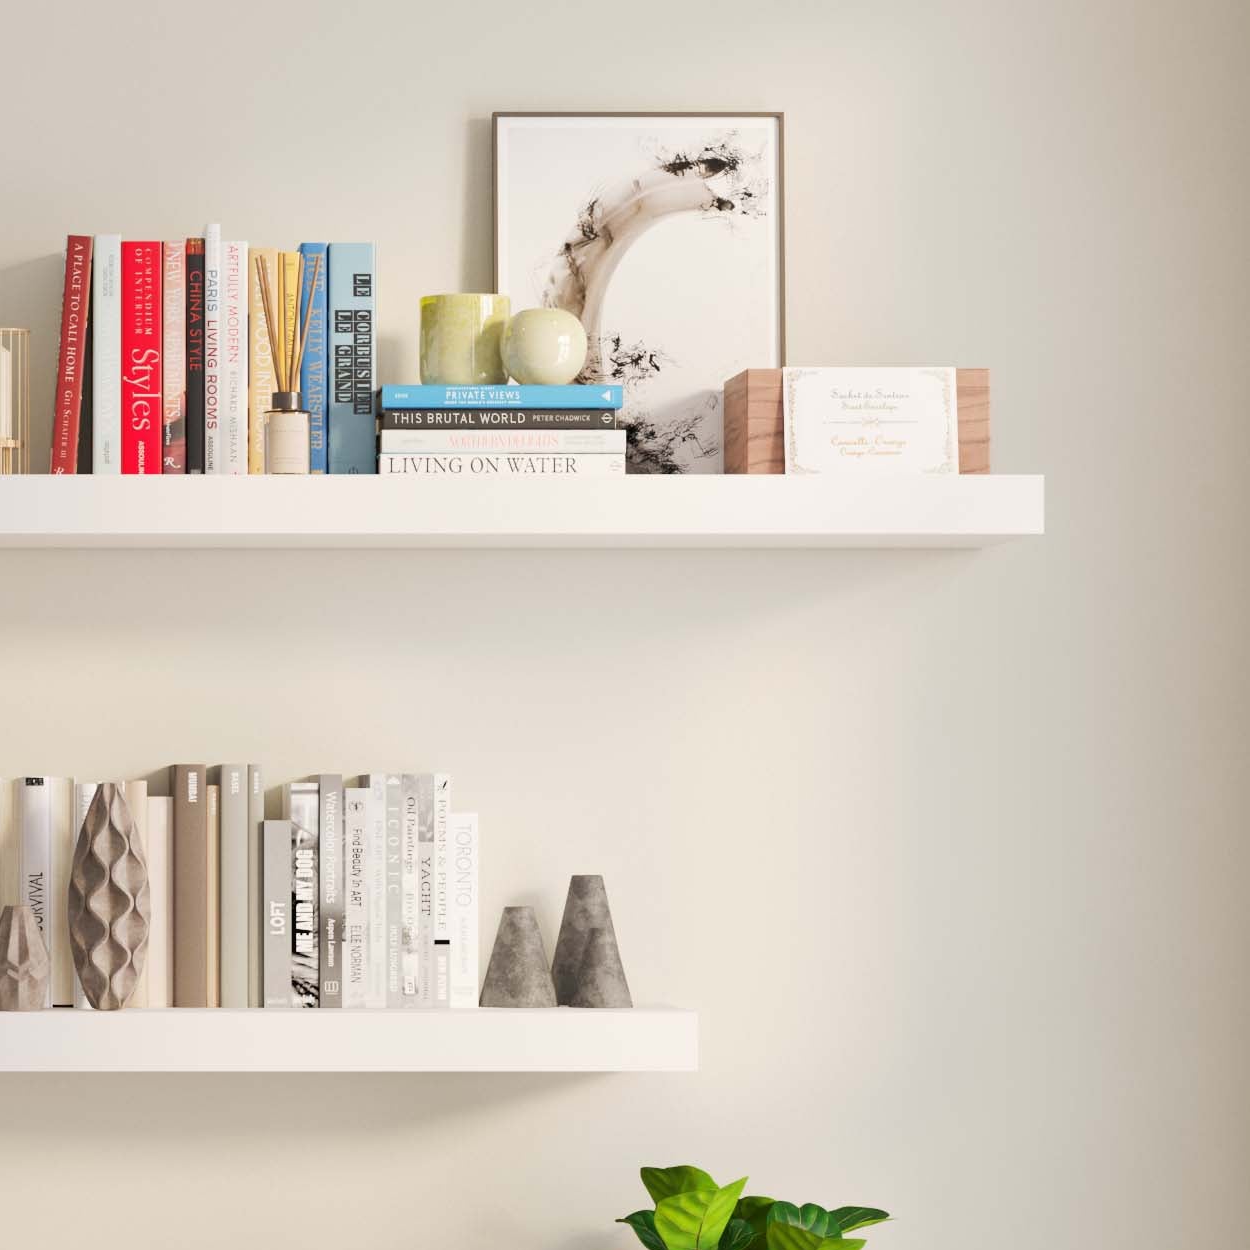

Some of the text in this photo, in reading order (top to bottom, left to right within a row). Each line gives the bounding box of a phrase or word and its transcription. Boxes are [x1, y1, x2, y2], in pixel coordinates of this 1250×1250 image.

[71, 255, 83, 290] PLACE
[74, 242, 84, 252] A
[166, 251, 180, 285] NEW
[228, 245, 239, 300] ARTFULLY
[70, 291, 80, 311] TO
[134, 248, 143, 335] OF INTERIOR
[144, 248, 153, 336] COMPENDIUM
[67, 312, 79, 343] CALL
[190, 270, 202, 371] CHINA STYLE
[228, 305, 239, 363] MODERN
[308, 309, 323, 354] KELLY
[354, 274, 371, 414] LE CORBUSIER
[65, 344, 77, 383] HOME
[207, 270, 218, 430] PARIS LIVING ROOMS
[335, 310, 352, 403] LE GRAND
[123, 348, 162, 432] Styles
[309, 360, 324, 450] WEARSTLER
[445, 391, 520, 400] PRIVATE VIEWS
[392, 412, 591, 425] THIS BRUTAL WORLD PETER CHADWICK
[389, 457, 578, 474] LIVING ON WATER
[326, 791, 338, 851] Watercolor
[352, 828, 362, 846] Find
[406, 796, 416, 874] Oil Paintings
[351, 847, 363, 877] Beauty
[388, 808, 399, 897] ICONIC
[437, 799, 446, 930] POEMS & PEOPLE
[455, 823, 472, 907] TORONTO
[28, 871, 44, 932] URVIVAL
[295, 849, 314, 953] ME AND MY DOG
[326, 856, 338, 904] Portraits
[351, 890, 362, 907] ART
[421, 857, 431, 916] YACHT
[270, 901, 286, 935] LOFT
[326, 918, 336, 940] Aspen
[351, 925, 362, 944] ELLE
[350, 945, 362, 984] NORMAN
